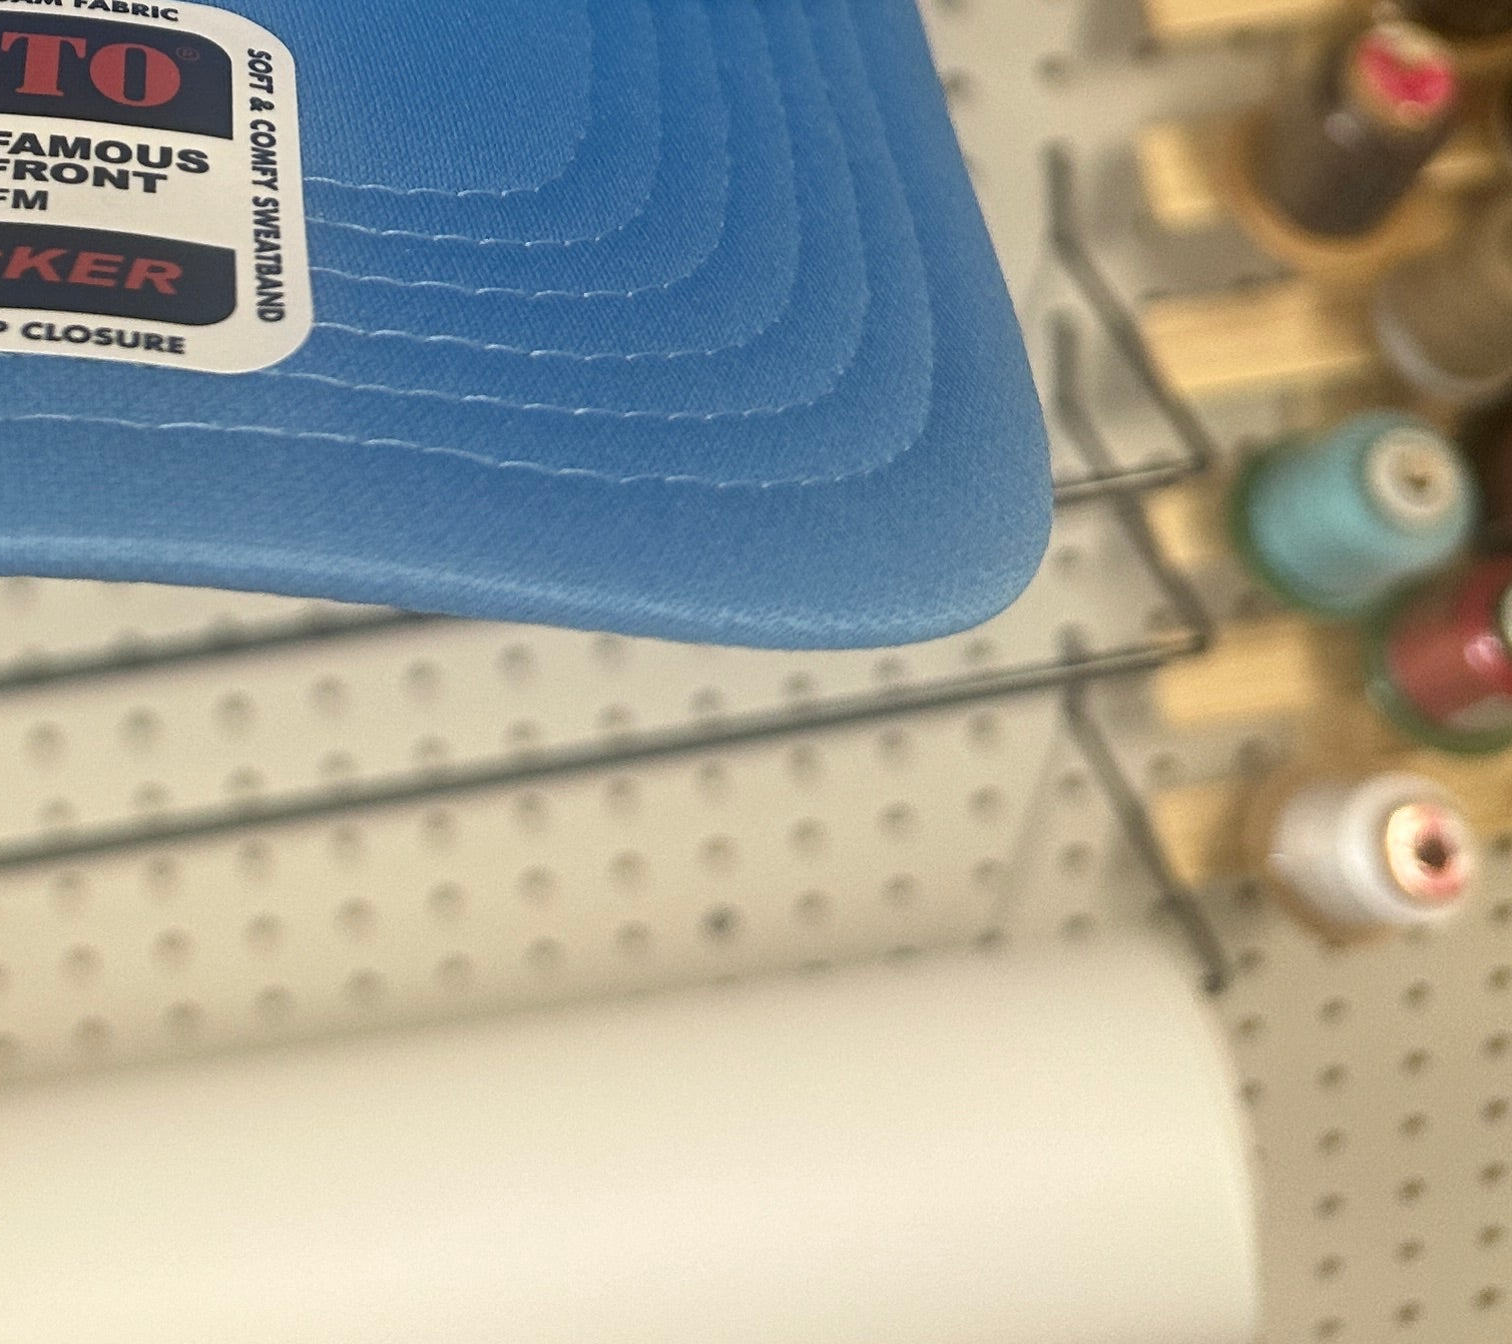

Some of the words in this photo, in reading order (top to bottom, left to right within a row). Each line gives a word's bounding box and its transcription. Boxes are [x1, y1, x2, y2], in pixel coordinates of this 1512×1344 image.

[247, 47, 274, 94] SOFT
[249, 96, 275, 113] &
[249, 119, 279, 191] COMFY
[251, 195, 286, 324] SWEATBAND
[20, 320, 186, 355] CLOSURE
